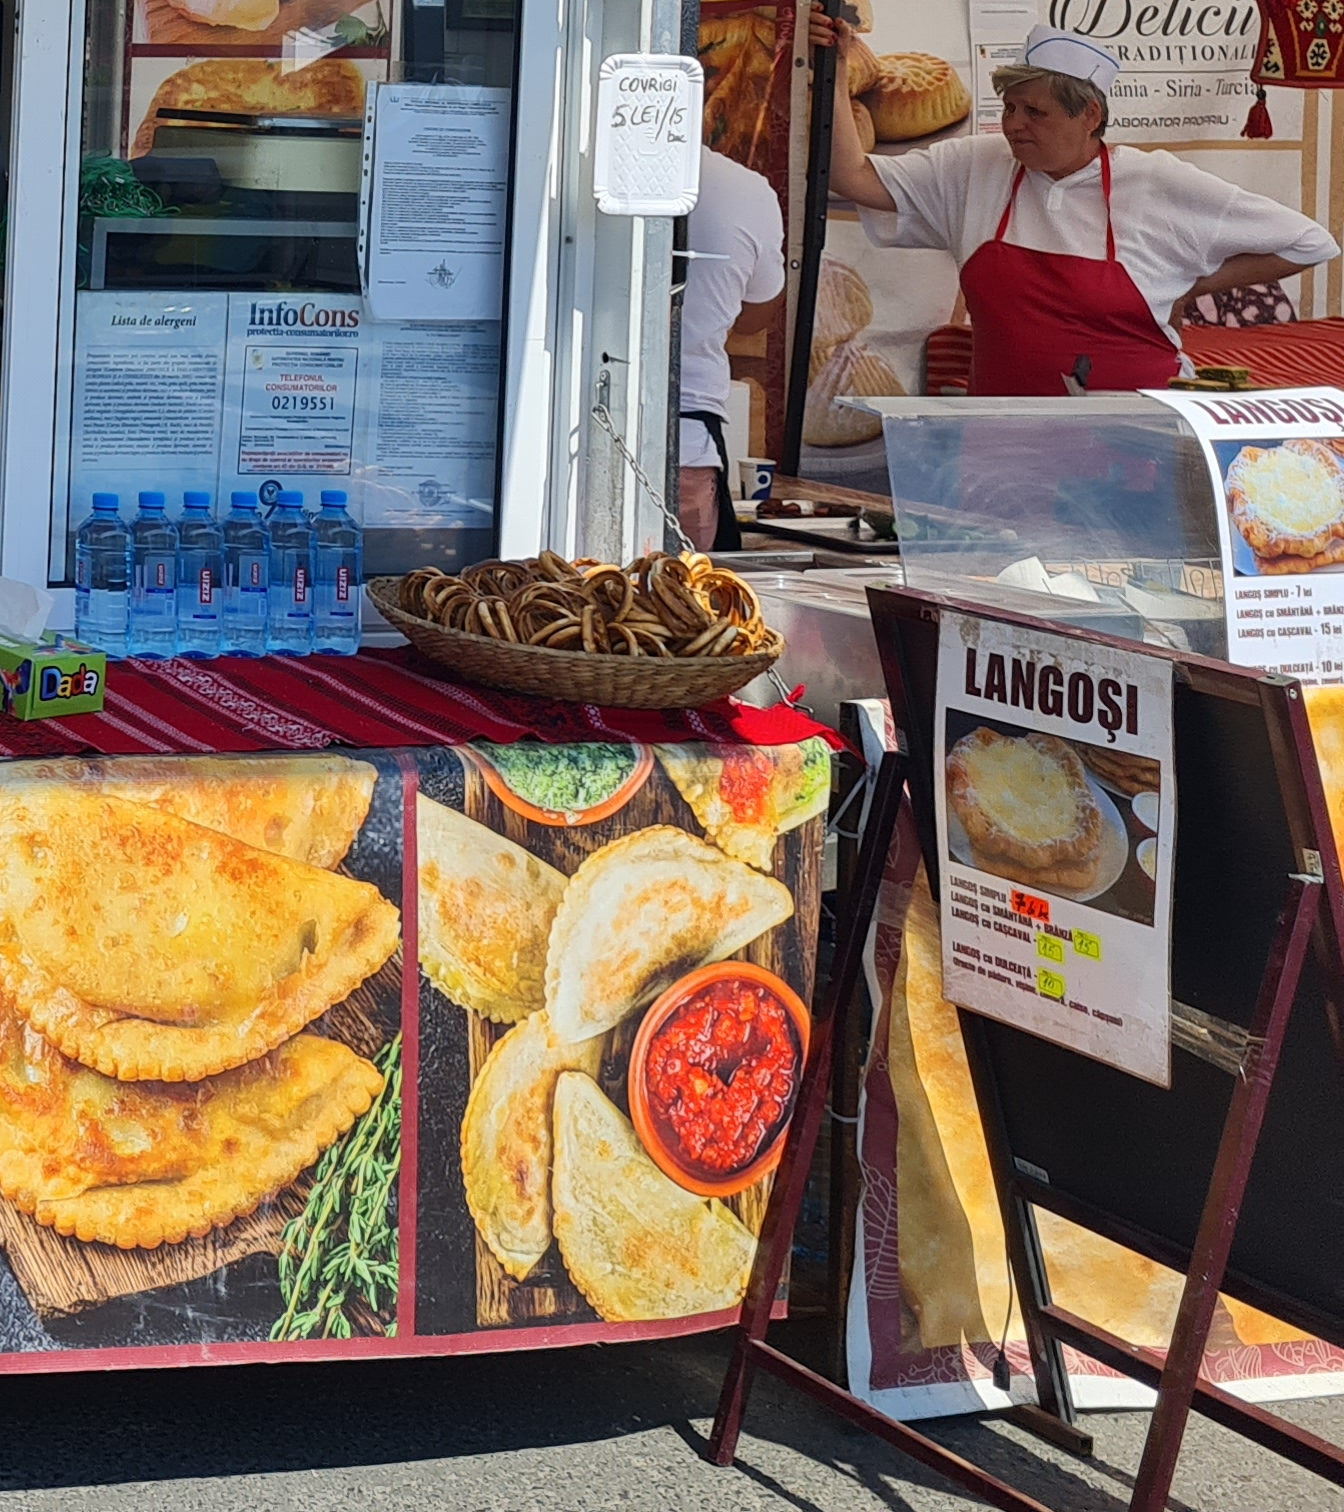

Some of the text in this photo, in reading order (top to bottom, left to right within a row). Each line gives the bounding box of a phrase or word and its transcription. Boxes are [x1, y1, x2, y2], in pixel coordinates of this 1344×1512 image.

[1166, 79, 1202, 98] Siria
[248, 301, 360, 328] InfoCons
[111, 314, 196, 330] Lista de alergeni
[280, 374, 323, 382] TELEFONUL
[265, 384, 337, 392] CONSUMATORILOR
[272, 396, 334, 410] 0219551
[1296, 585, 1301, 598] 7
[1320, 622, 1330, 635] 15
[1321, 660, 1332, 672] 10
[40, 663, 99, 701] Dada
